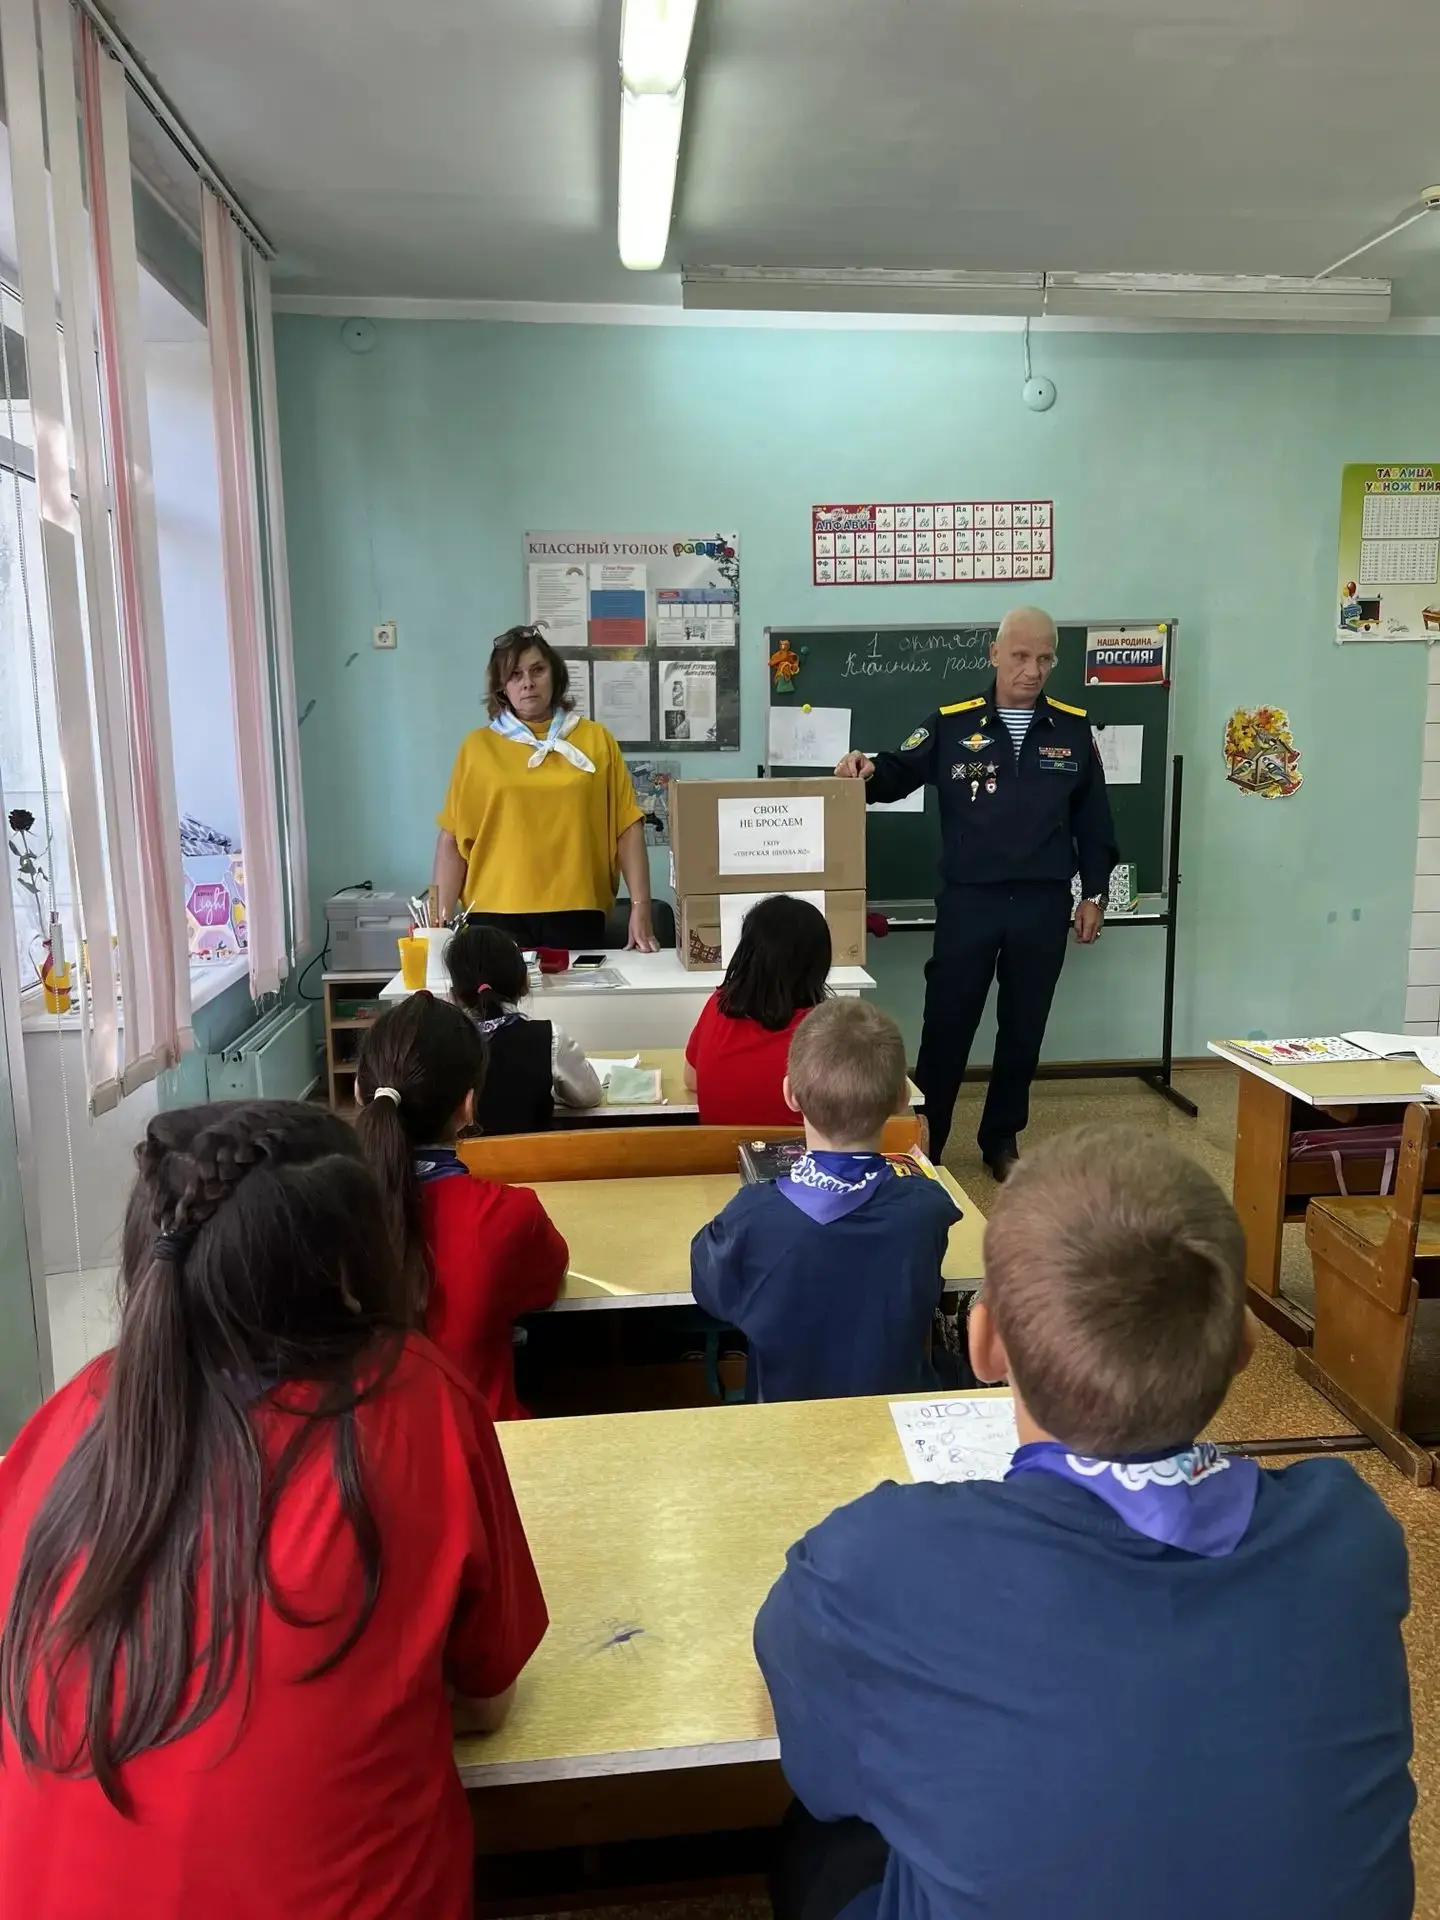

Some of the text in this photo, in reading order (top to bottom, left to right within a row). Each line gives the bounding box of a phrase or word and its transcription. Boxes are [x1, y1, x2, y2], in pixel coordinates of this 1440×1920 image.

[1376, 467, 1433, 479] ТАБЛИЦА
[816, 520, 876, 531] АЛФАВИТ
[529, 540, 609, 554] КЛАССНЫЙ
[612, 543, 668, 555] УГОЛОК
[867, 628, 992, 658] 1 октябр
[1097, 638, 1119, 646] НАША
[1121, 637, 1152, 646] РОДИНА
[1096, 650, 1154, 664] РОССИЯ!
[943, 655, 991, 680] рабо
[753, 805, 789, 814] СВОИХ
[740, 818, 803, 828] НЕ БРОСАЕМ
[193, 887, 226, 925] Light
